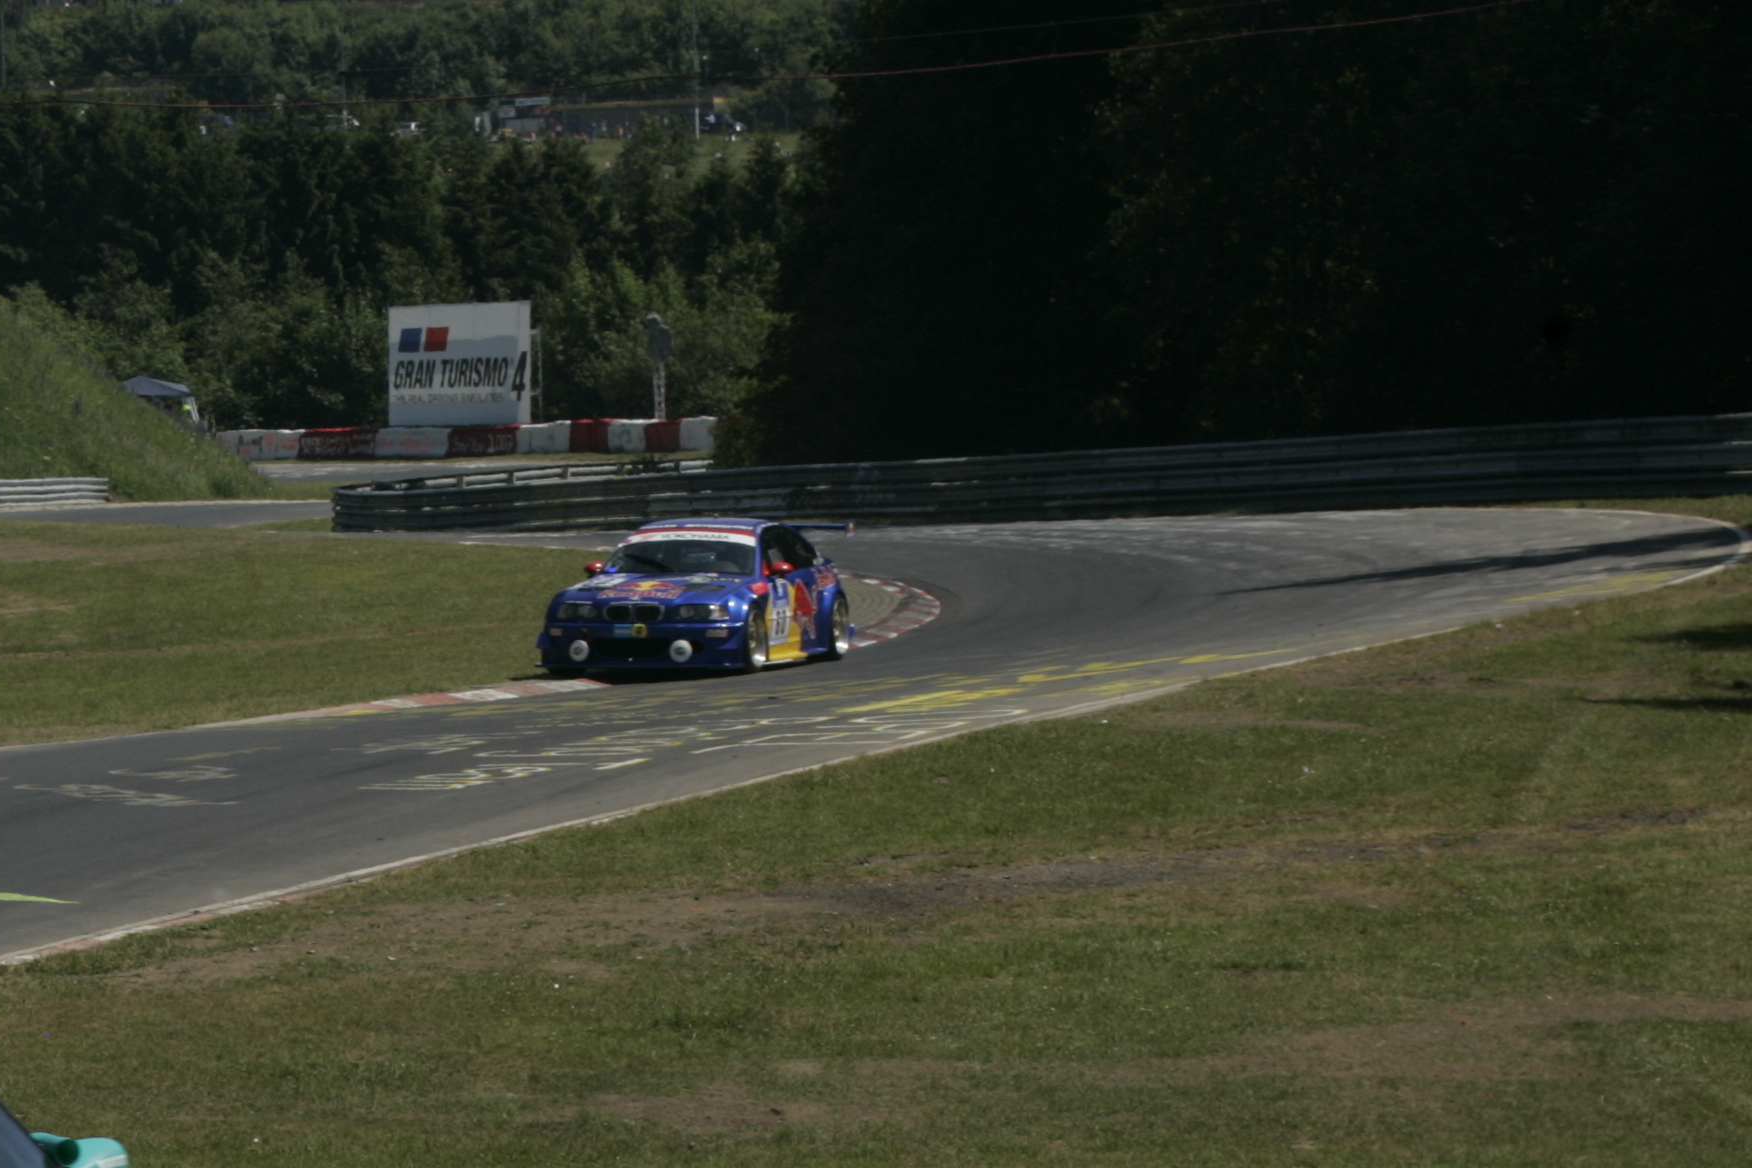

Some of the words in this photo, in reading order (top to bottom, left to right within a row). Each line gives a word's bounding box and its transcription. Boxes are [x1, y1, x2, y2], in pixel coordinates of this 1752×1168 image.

[393, 359, 436, 390] GRAN
[440, 356, 509, 388] TURISMO
[511, 350, 528, 402] 4
